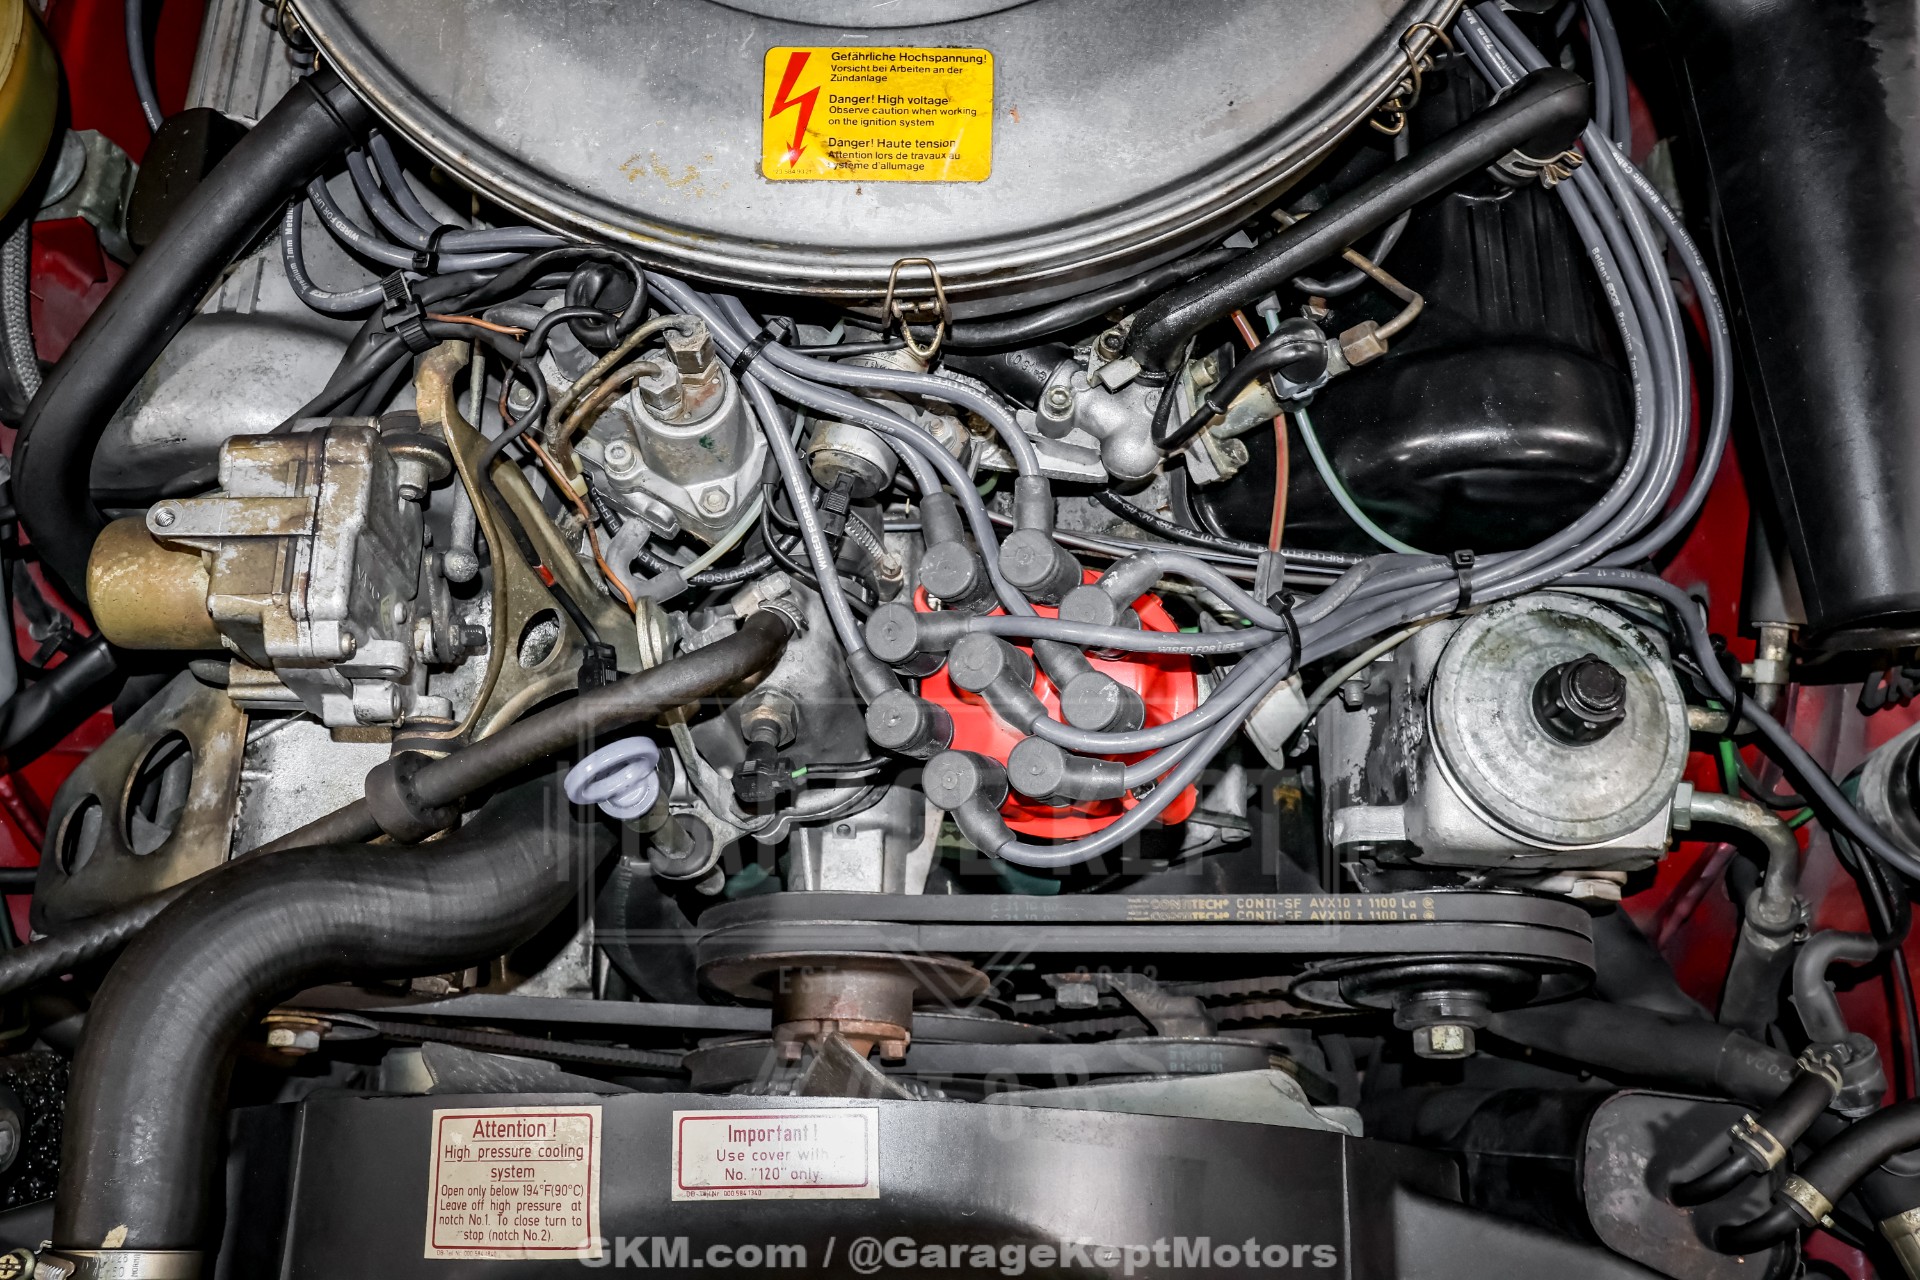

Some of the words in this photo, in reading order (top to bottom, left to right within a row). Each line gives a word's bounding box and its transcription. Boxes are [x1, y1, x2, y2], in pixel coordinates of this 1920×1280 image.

[831, 51, 896, 62] Gefährliche
[899, 53, 987, 65] Hochspannung!
[831, 64, 870, 72] Vorsicht
[872, 65, 887, 73] bei
[890, 65, 931, 73] Arbeiten
[947, 66, 963, 74] der
[830, 73, 888, 83] Zündanlage
[829, 95, 875, 106] Danger!
[877, 95, 904, 106] High
[829, 106, 870, 115] Observe
[872, 107, 909, 115] caution
[911, 107, 938, 115] when
[940, 106, 977, 117] working
[843, 118, 858, 126] the
[860, 117, 897, 128] ignition
[899, 118, 935, 128] system
[828, 137, 874, 149] Danger!
[877, 138, 912, 149] Haute
[915, 138, 956, 149] tension
[828, 150, 873, 160] Attention
[875, 151, 893, 160] lors
[895, 151, 908, 160] de
[911, 152, 947, 161] travaux
[1633, 172, 1661, 204] Metallic
[322, 207, 338, 224] FOR
[1661, 204, 1678, 226] 7mm
[335, 220, 360, 242] WIRED
[286, 239, 295, 260] 7mm
[1679, 227, 1703, 266] Premium
[802, 511, 817, 534] FOR
[811, 534, 828, 571] WIRED
[1195, 644, 1216, 653] FOR
[1236, 898, 1302, 909] CONTI-SF
[1309, 898, 1351, 909] AVX10
[1368, 898, 1397, 909] 1100
[1401, 898, 1417, 909] La
[472, 1118, 547, 1138] Attention
[444, 1144, 470, 1162] High
[478, 1146, 531, 1162] pressure
[538, 1143, 584, 1161] cooling
[716, 1149, 745, 1161] Use
[752, 1150, 791, 1161] cover
[490, 1165, 535, 1182] system
[725, 1168, 747, 1181] No.
[441, 1184, 464, 1198] Open
[468, 1185, 486, 1199] only
[490, 1184, 519, 1197] below
[440, 1199, 467, 1211] Leave
[471, 1199, 485, 1211] off
[490, 1199, 511, 1214] high
[516, 1200, 562, 1214] pressure
[571, 1200, 582, 1211] at
[439, 1214, 464, 1225] notch
[498, 1214, 508, 1226] To
[514, 1215, 540, 1226] close
[545, 1215, 567, 1227] turn
[572, 1216, 582, 1227] to
[463, 1230, 484, 1244] stop
[488, 1229, 519, 1242] (notch
